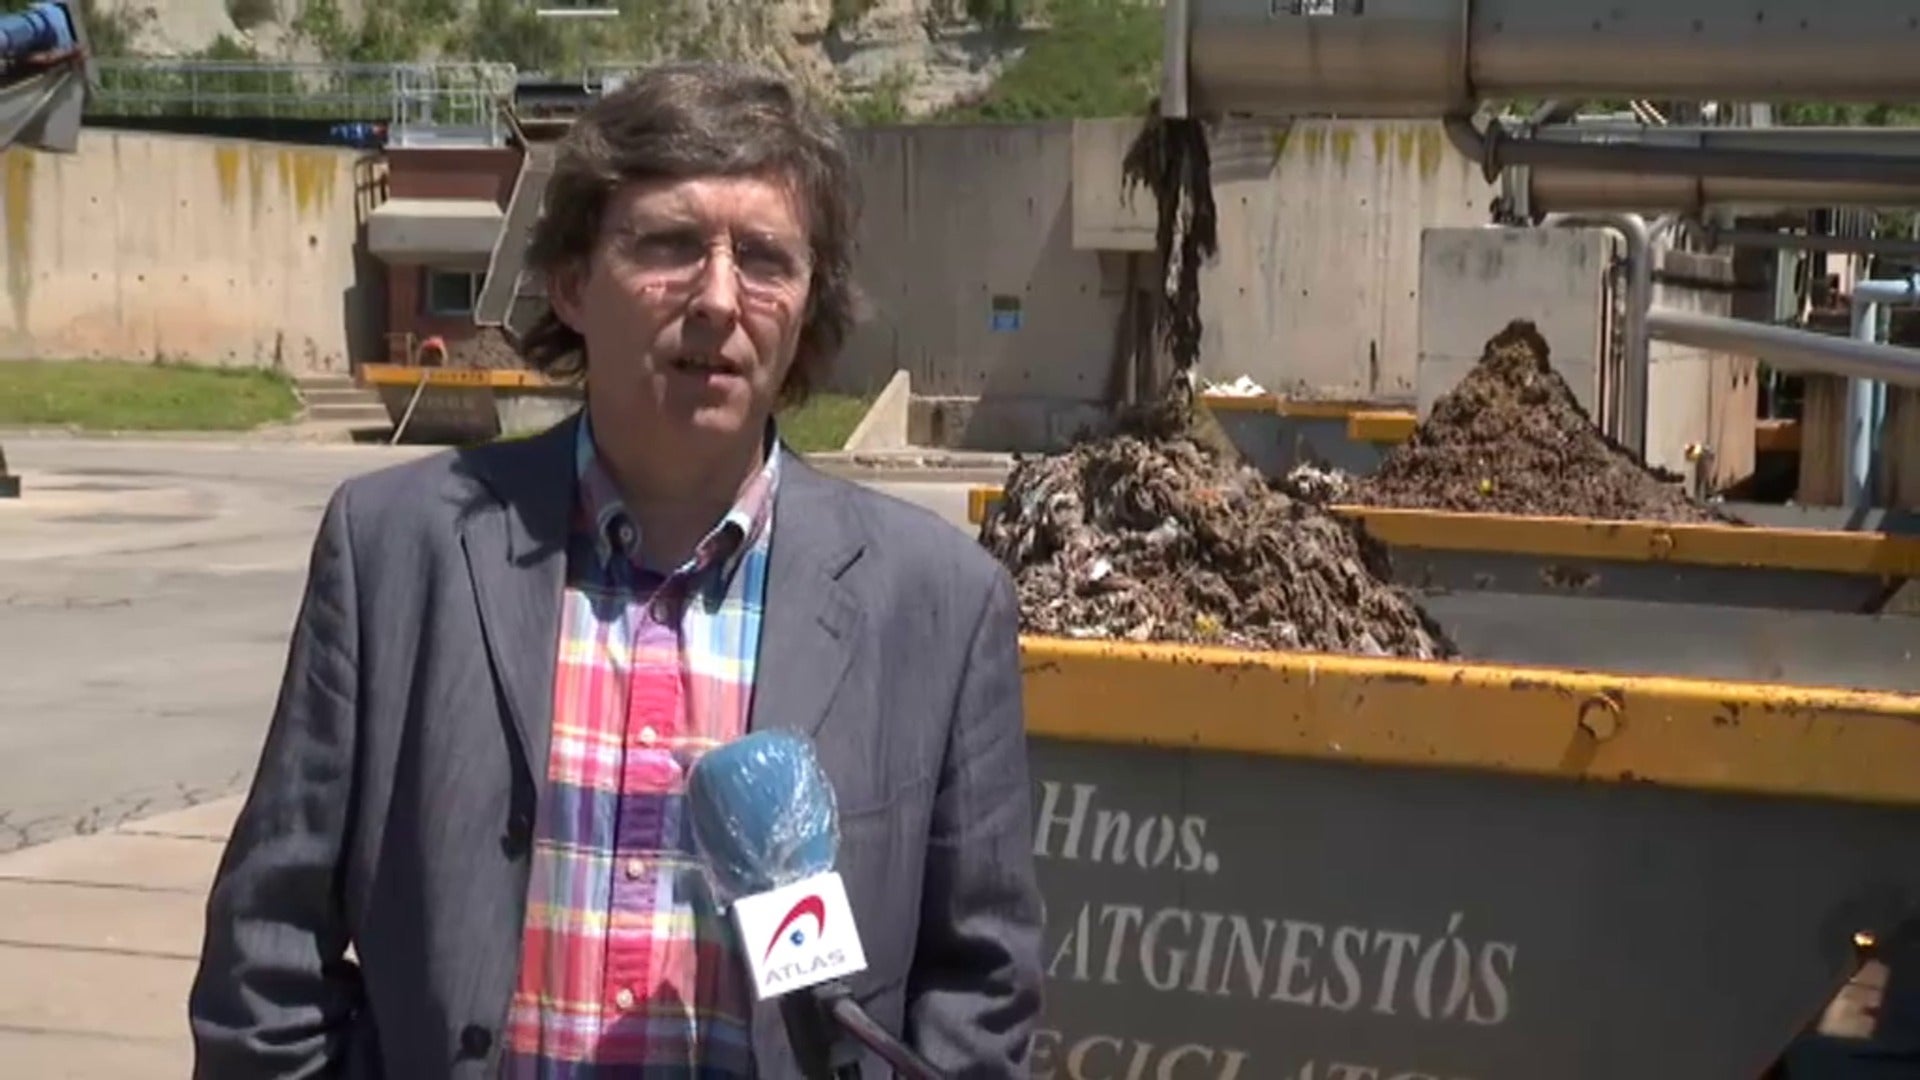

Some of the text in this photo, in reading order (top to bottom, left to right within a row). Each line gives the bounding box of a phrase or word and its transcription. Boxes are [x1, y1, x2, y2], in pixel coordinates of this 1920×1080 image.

[1033, 779, 1220, 874] Hnos.
[766, 949, 846, 985] ATLAS
[1041, 899, 1518, 1025] ATGINESTÓS
